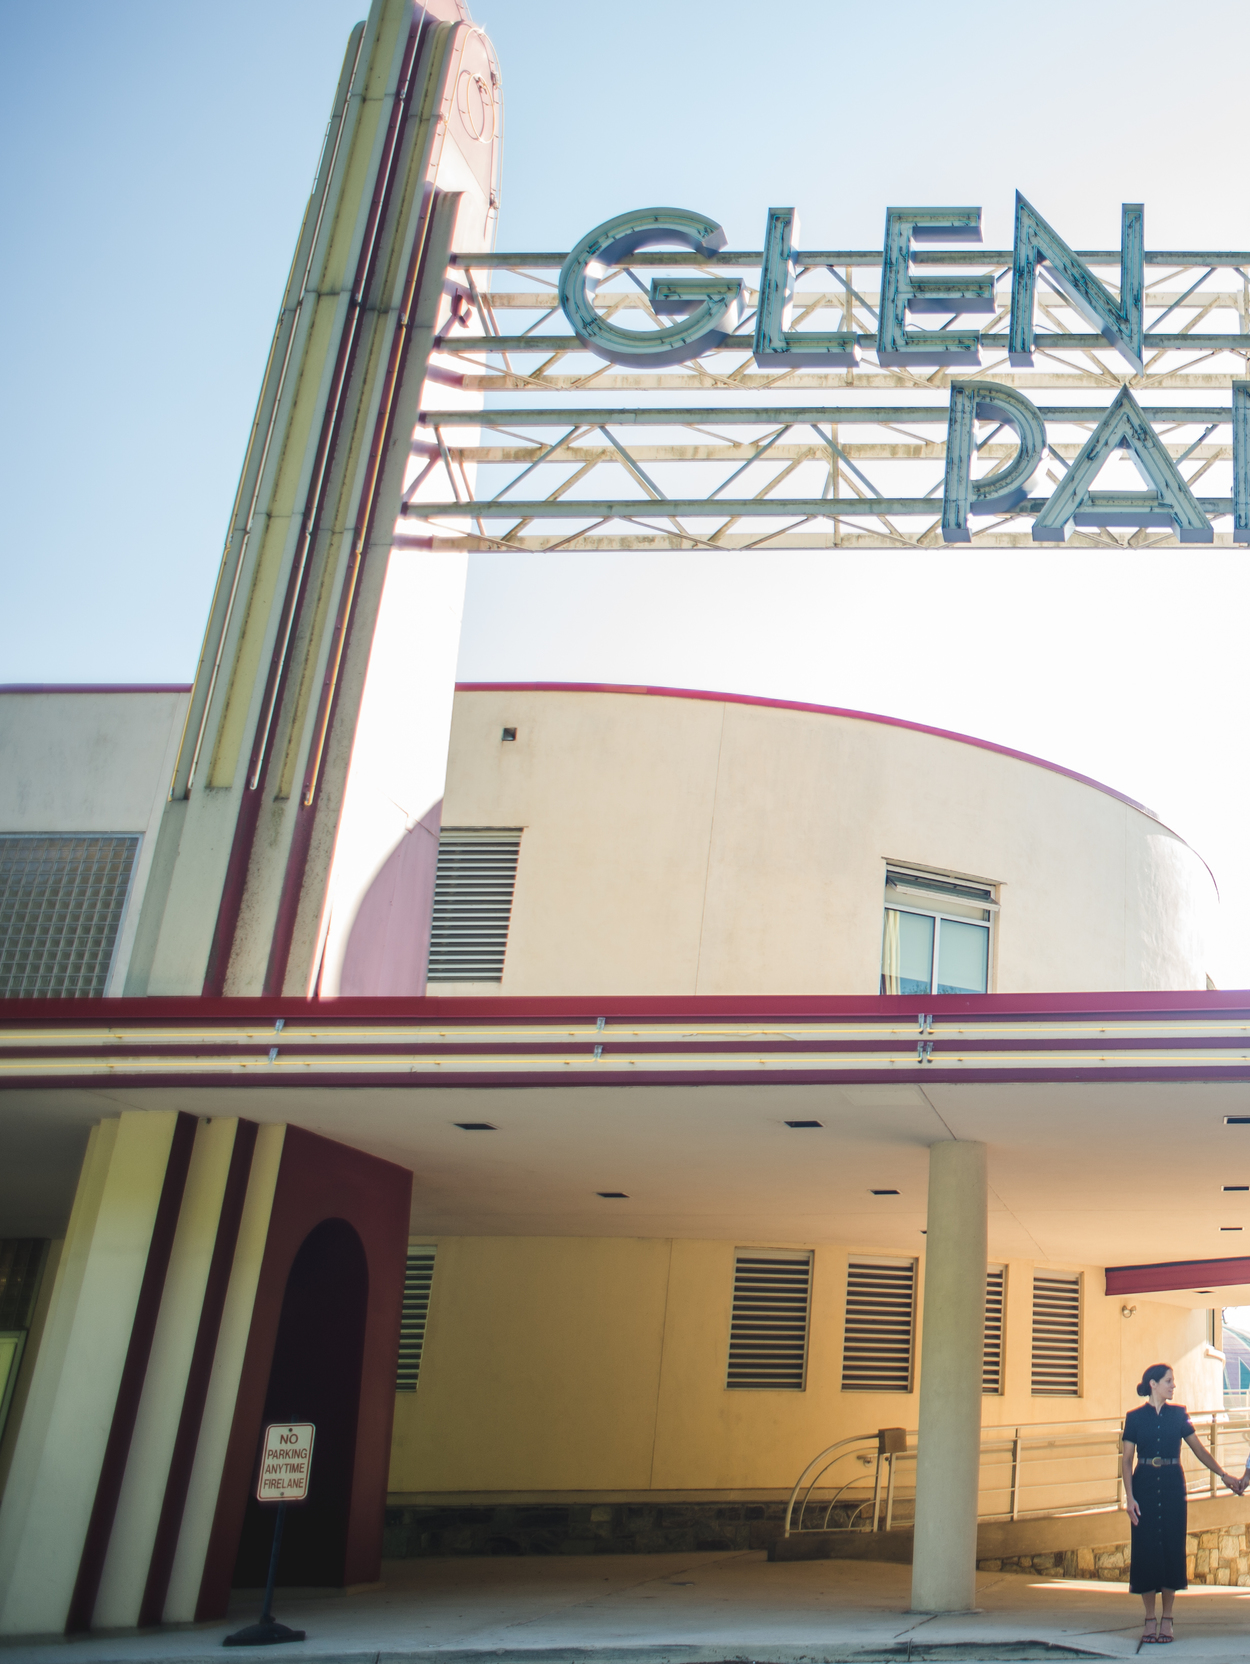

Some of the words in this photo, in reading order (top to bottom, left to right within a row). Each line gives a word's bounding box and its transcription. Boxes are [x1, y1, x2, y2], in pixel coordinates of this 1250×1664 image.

[558, 188, 1145, 378] GLEN
[279, 1433, 299, 1445] NO
[267, 1448, 308, 1460] PARKING
[264, 1463, 305, 1474] ANYTIME
[263, 1478, 304, 1489] FIRELANE
